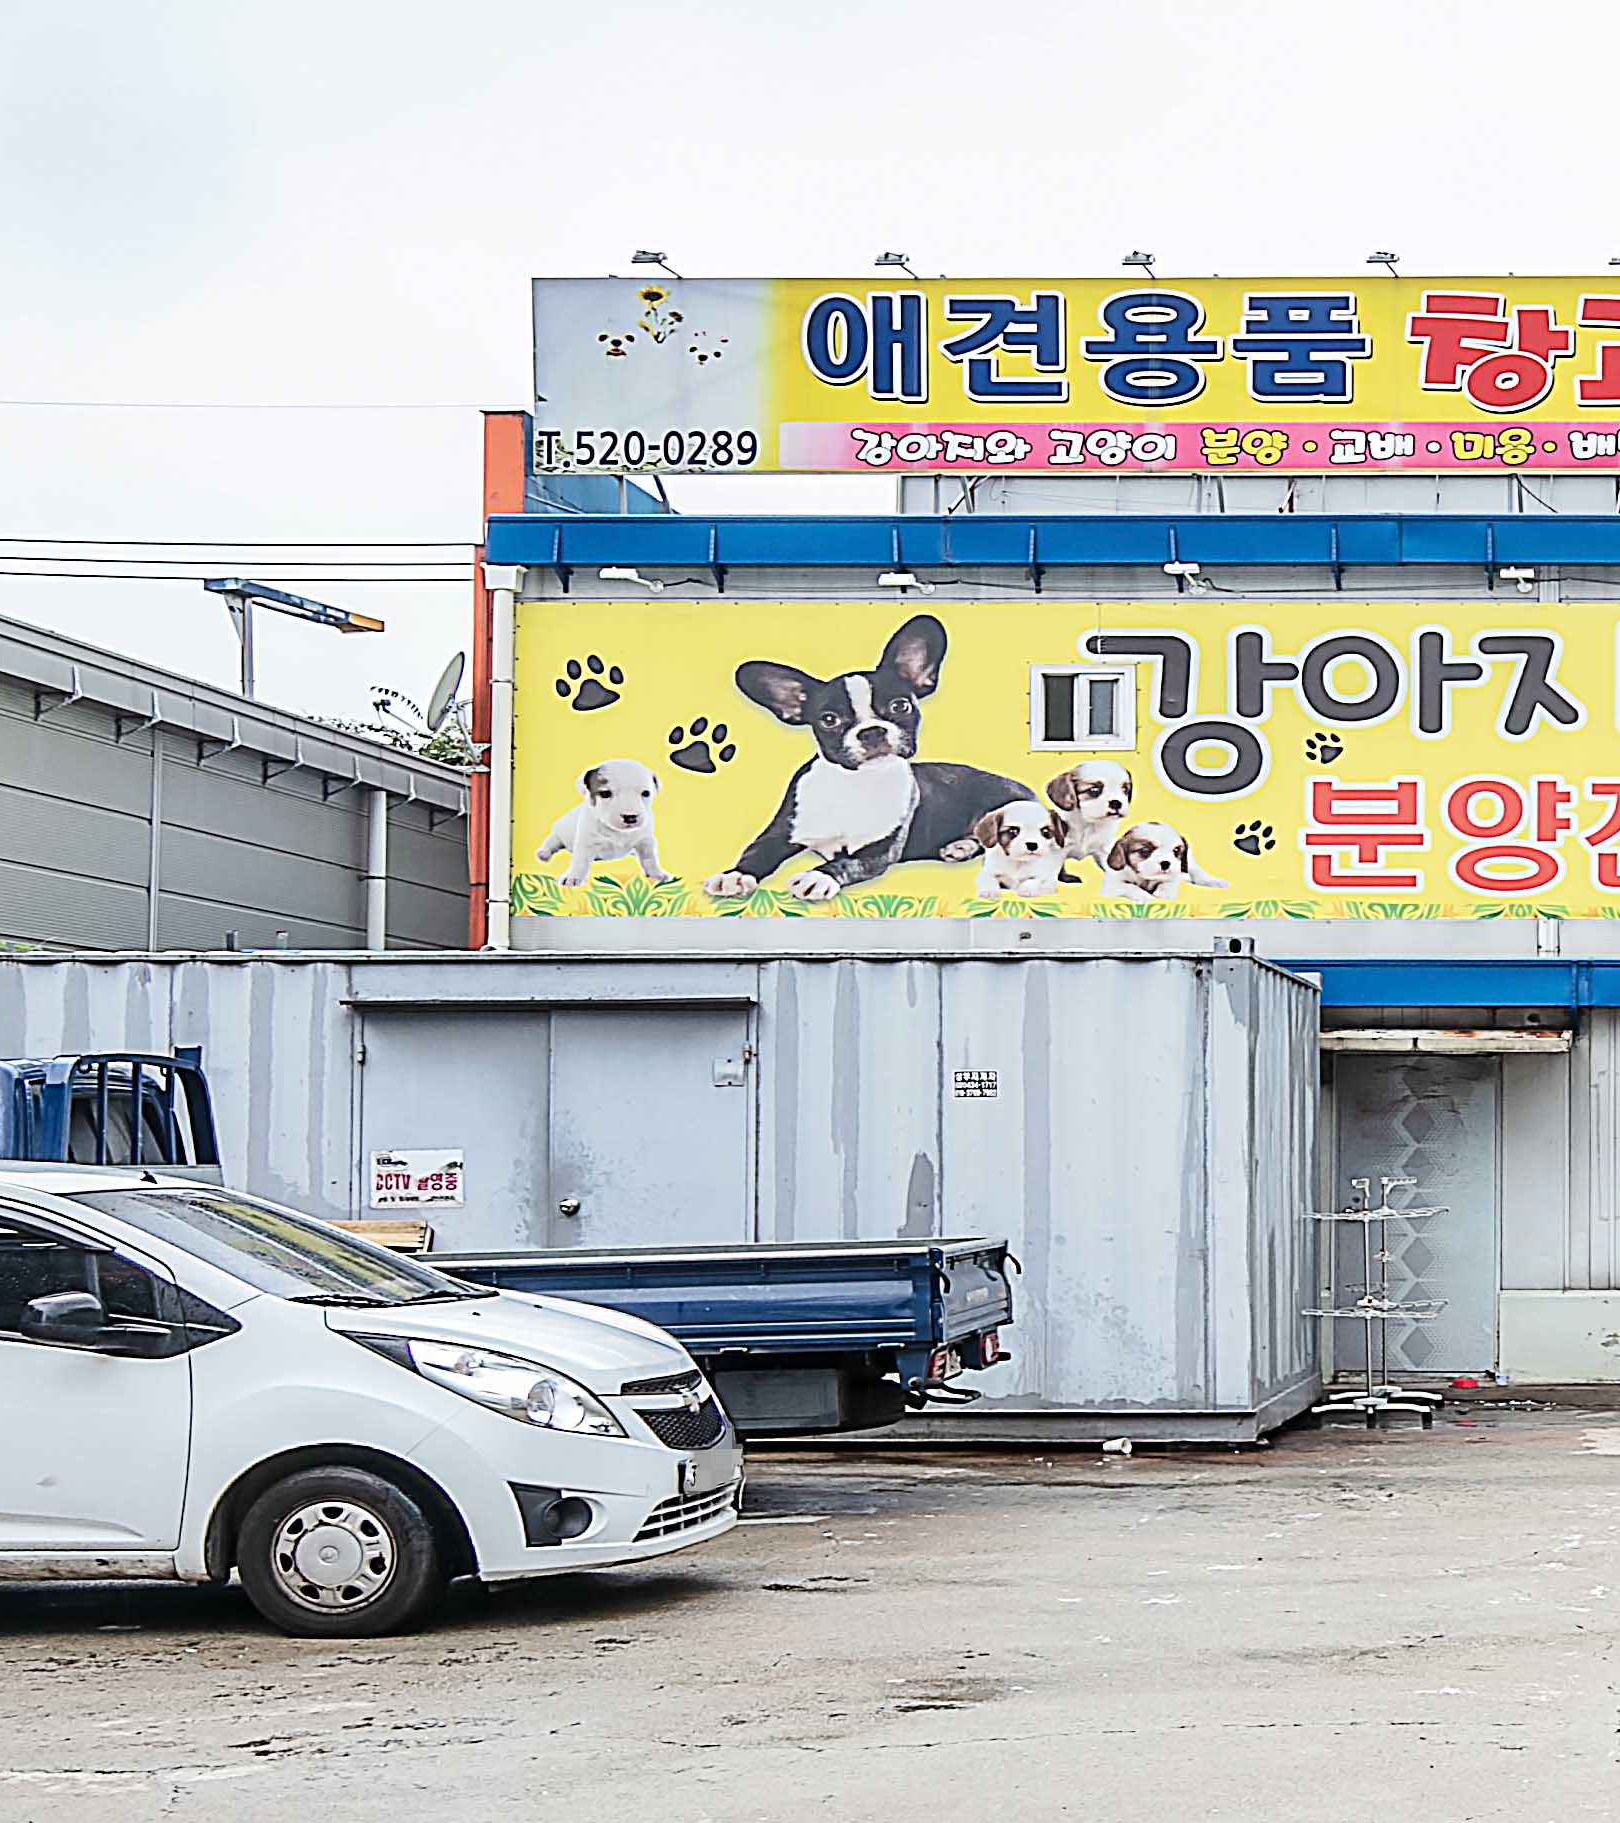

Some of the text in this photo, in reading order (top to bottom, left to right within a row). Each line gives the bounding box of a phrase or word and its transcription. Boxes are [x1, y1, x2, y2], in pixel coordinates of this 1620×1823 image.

[805, 290, 1370, 404] 애견용품
[537, 430, 758, 468] T.520-0289
[852, 428, 1032, 464] 강아지와
[1048, 429, 1177, 466] 고양이
[1200, 427, 1289, 465] 분양
[1330, 429, 1415, 464] 교배
[1450, 427, 1536, 466] 미용
[376, 1174, 411, 1191] CCTV
